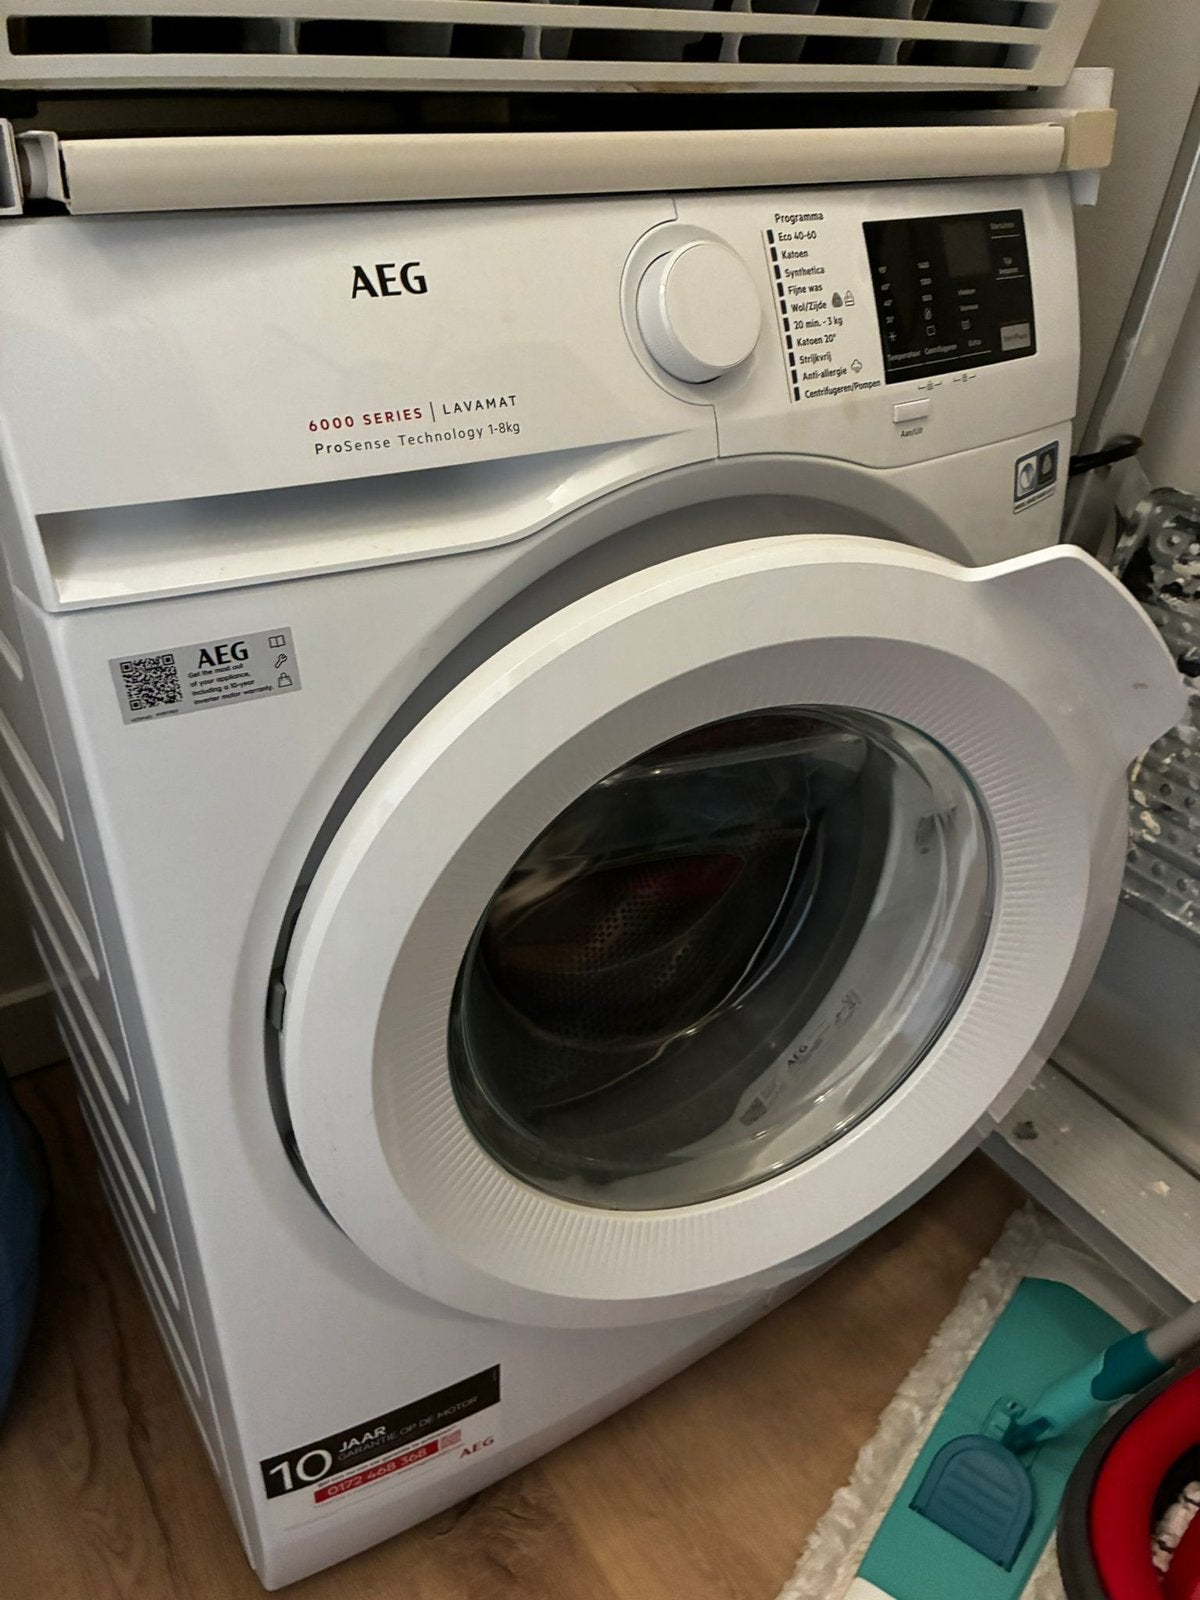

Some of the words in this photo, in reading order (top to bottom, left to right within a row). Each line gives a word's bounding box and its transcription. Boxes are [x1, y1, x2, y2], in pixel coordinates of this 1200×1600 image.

[774, 212, 824, 225] Programma
[778, 231, 793, 242] Eco
[794, 230, 817, 241] 40-60
[781, 249, 809, 260] Katoen
[784, 265, 826, 279] Synthetica
[351, 261, 429, 299] AEG
[787, 285, 807, 296] Fijne
[808, 284, 823, 293] was
[790, 300, 828, 313] Wol/Zijde
[794, 320, 804, 330] 20
[805, 319, 822, 329] min.
[827, 316, 833, 326] 3
[833, 316, 843, 326] kg
[796, 336, 823, 347] Katoen
[799, 351, 832, 364] Strijkvrij
[802, 366, 848, 381] Anti-allergie
[804, 380, 881, 399] Centrifugeren/Pompen
[308, 415, 355, 432] 6000
[362, 407, 423, 426] SERIES
[442, 394, 517, 415] LAVAMAT
[314, 438, 391, 455] ProSense
[397, 426, 483, 447] Technology
[488, 421, 521, 436] 1-8kg
[198, 640, 249, 669] AEG
[188, 671, 201, 679] Get
[201, 668, 213, 676] the
[214, 666, 231, 674] most
[189, 680, 198, 688] of
[199, 678, 215, 687] your
[216, 672, 251, 684] appliance,
[192, 687, 223, 697] including
[230, 679, 255, 690] 10-year
[221, 691, 241, 700] motor
[337, 1432, 397, 1462] GARANTIE
[399, 1422, 417, 1436] OP
[418, 1414, 434, 1428] DE
[436, 1396, 479, 1420] MOTOR
[459, 1435, 495, 1460] AEG
[269, 1449, 333, 1491] 10
[338, 1425, 387, 1453] JAAR
[327, 1477, 362, 1496] 0172
[367, 1461, 397, 1480] 468
[400, 1447, 428, 1466] 368
